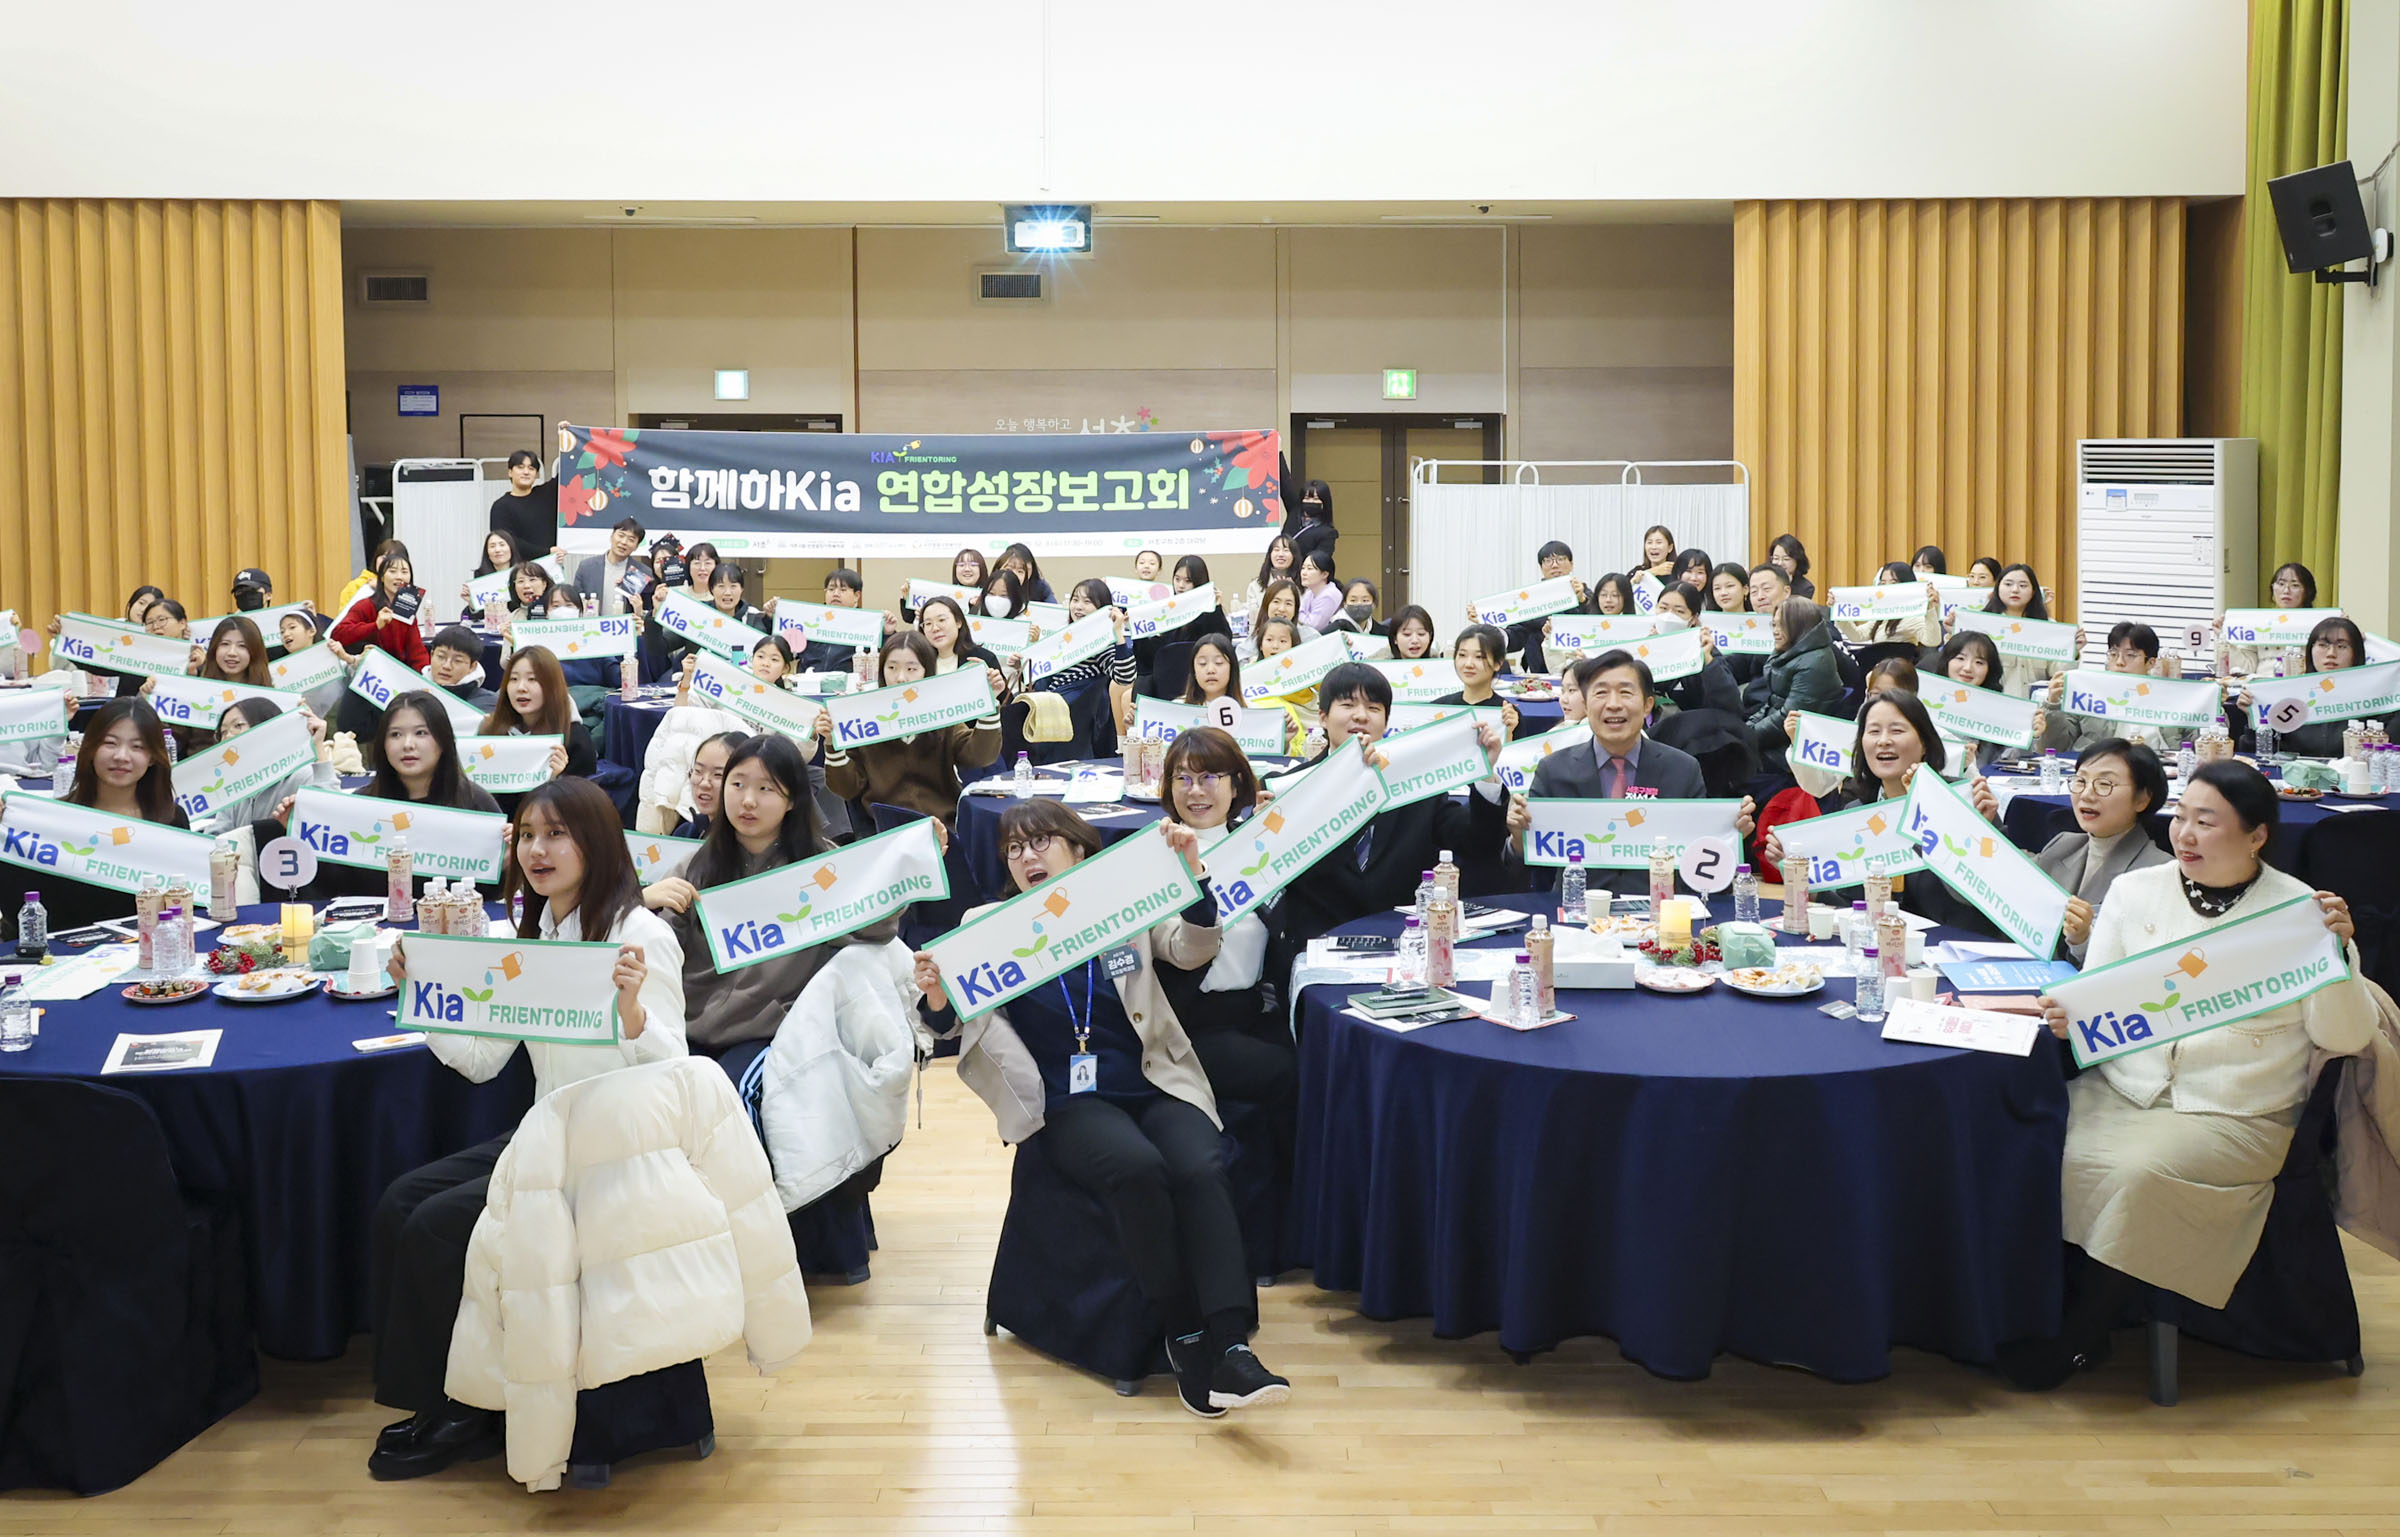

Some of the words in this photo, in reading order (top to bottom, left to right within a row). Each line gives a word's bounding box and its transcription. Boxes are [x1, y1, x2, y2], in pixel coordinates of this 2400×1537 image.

[995, 418, 1019, 431] 오늘
[1023, 417, 1072, 431] 행복하고
[871, 451, 895, 463] KIA
[648, 465, 861, 511] 함께하Kia
[877, 468, 1189, 513] 연합성장보고회
[912, 594, 926, 607] Ki
[1482, 611, 1508, 626] Kia
[1518, 597, 1573, 617] FRIENTORING
[1634, 586, 1653, 612] Kia
[1837, 604, 1860, 617] Kia
[1871, 605, 1924, 616] FRIENTORING
[661, 607, 688, 631] Kia
[1134, 620, 1157, 636] Kia
[2228, 626, 2255, 641] Kia
[2269, 632, 2311, 640] FRIENTO
[816, 628, 874, 643] FRIENTORING
[1555, 633, 1581, 648] Kia
[1741, 638, 1774, 648] FRIENT
[2001, 641, 2069, 657] FRIENTORING
[2190, 631, 2201, 646] 9
[62, 636, 94, 660] Kia
[109, 654, 181, 675] FRIENTORING
[1030, 660, 1053, 678] Kia
[1061, 632, 1111, 663] FRIENTORIN
[280, 665, 339, 692] RIENTORING
[358, 671, 391, 704] Kia
[1281, 657, 1346, 689] FRIENTORING
[155, 695, 191, 720] Kia
[693, 670, 723, 698] Kia
[736, 697, 805, 733] FRIENTORING
[2071, 691, 2107, 715] Kia
[2125, 706, 2210, 723] FRIENTORING
[2276, 703, 2300, 723] 5
[0, 719, 58, 735] NTORING
[838, 719, 880, 742] Kia
[897, 698, 986, 729] FRIENTORING
[1142, 719, 1177, 742] Kia
[1219, 706, 1235, 727] 6
[1937, 711, 2024, 741] FRIENTORING
[1802, 738, 1841, 767] Kia
[224, 747, 306, 797] FRIENTORING
[473, 769, 548, 784] FRIENTORING
[1389, 759, 1477, 798] ENTORING
[1497, 766, 1524, 788] Kia
[4, 827, 59, 866] Kia
[301, 821, 349, 856] Kia
[374, 845, 490, 872] FNTORING
[1214, 879, 1255, 918] ia
[1270, 789, 1378, 875] FRIENTORING
[1535, 830, 1586, 859] Kia
[279, 849, 299, 877] 3
[1694, 848, 1721, 881] 2
[722, 919, 786, 959] Kia
[810, 873, 933, 932] FRIENTORING
[1953, 861, 2044, 948] FRIENTORING
[956, 958, 1027, 1007] Kia
[1049, 881, 1184, 962] FRIENTORING
[413, 980, 464, 1023] Kia
[488, 1003, 603, 1030] FRIENTORING
[2076, 1009, 2154, 1054] Kia
[2180, 955, 2330, 1023] FRIENTORING
